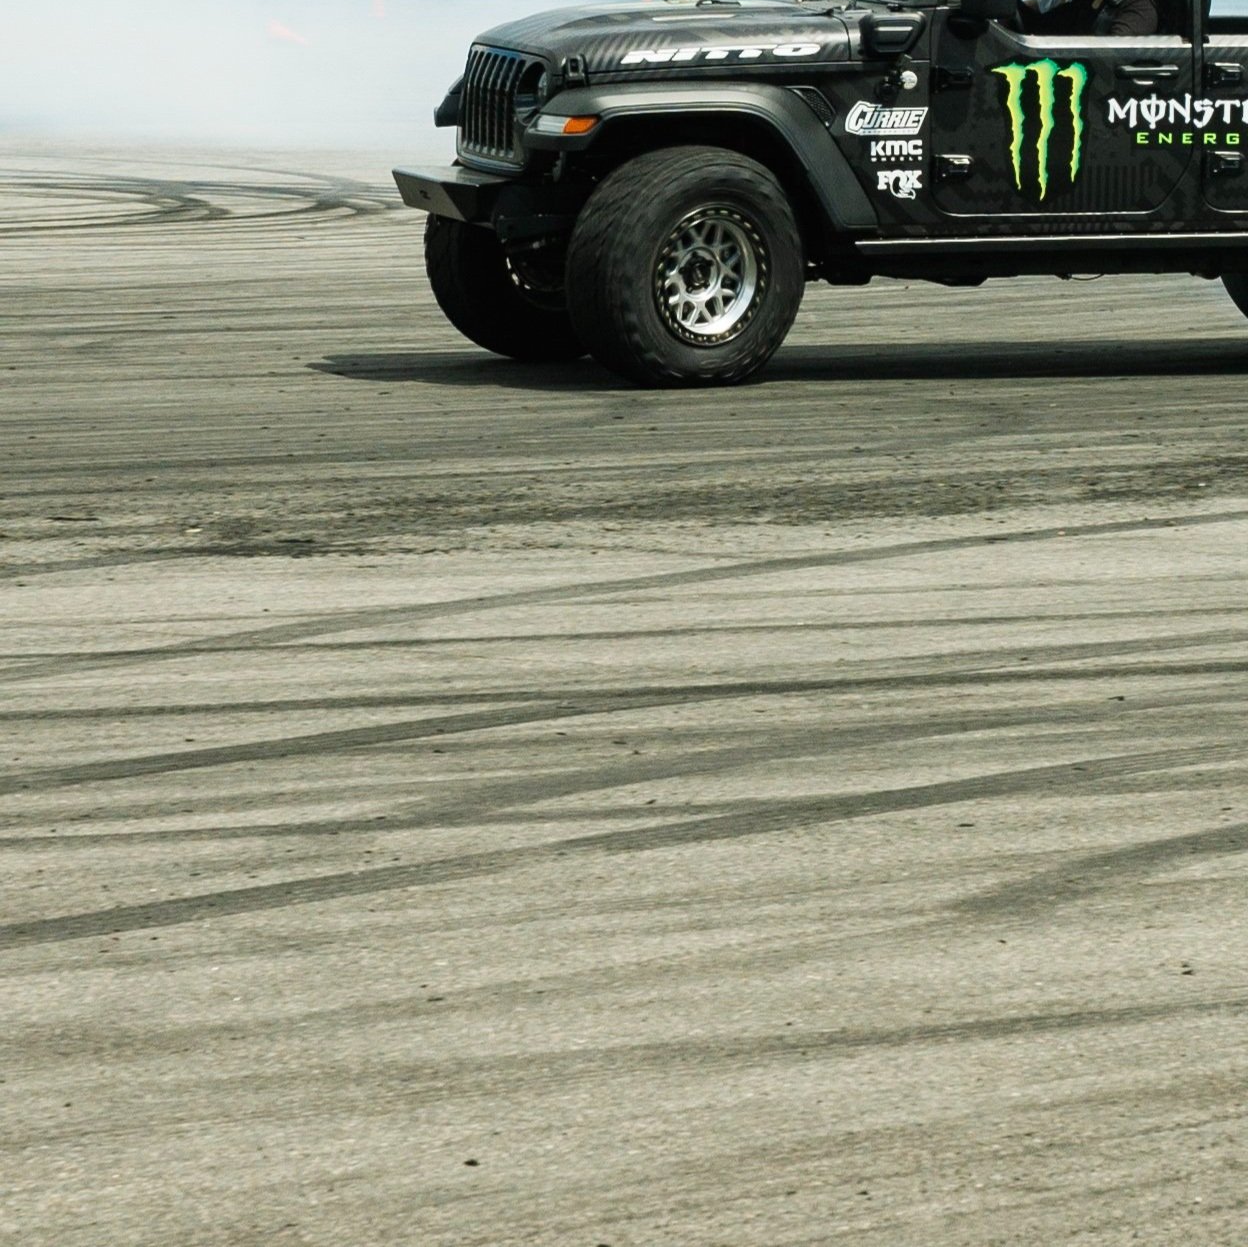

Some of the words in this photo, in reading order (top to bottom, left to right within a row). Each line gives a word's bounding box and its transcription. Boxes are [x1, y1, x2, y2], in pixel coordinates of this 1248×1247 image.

[620, 43, 821, 64] NITTO
[848, 103, 924, 132] CURRIE
[870, 139, 923, 156] KMC
[877, 169, 923, 200] FOX
